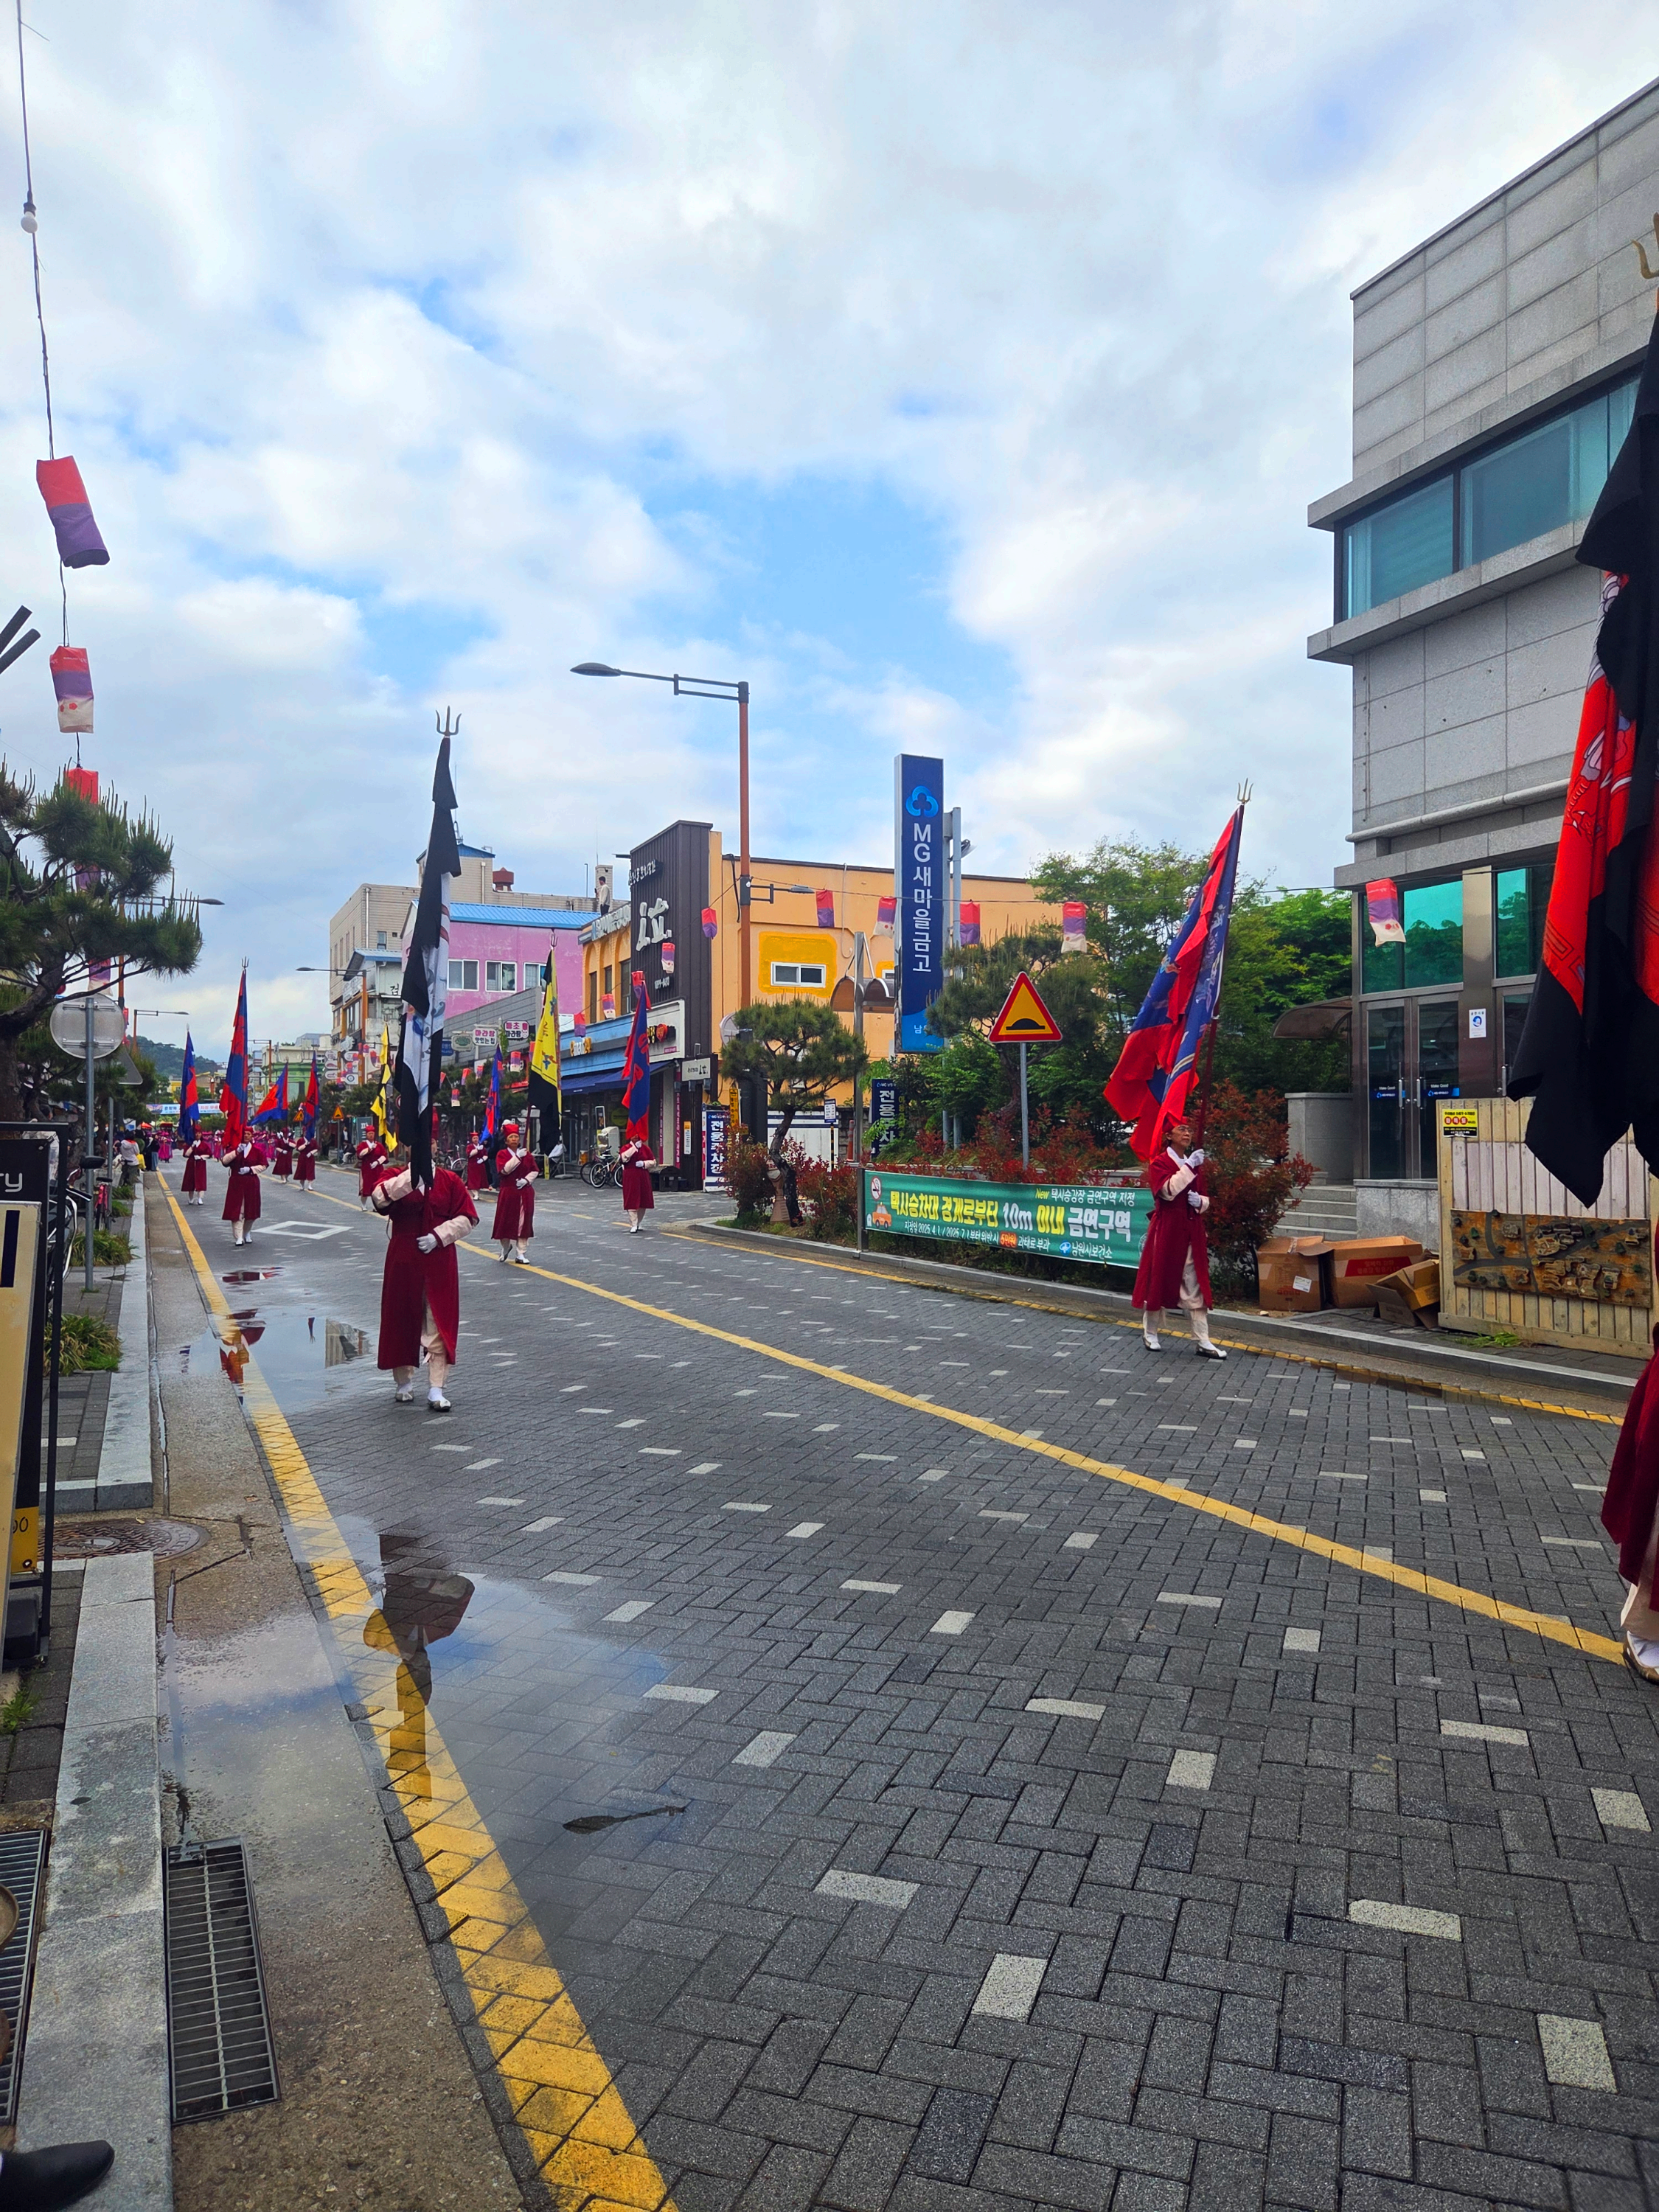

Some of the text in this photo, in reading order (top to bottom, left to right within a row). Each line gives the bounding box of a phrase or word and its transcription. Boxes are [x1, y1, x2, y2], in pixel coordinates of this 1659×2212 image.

[913, 823, 932, 973] MG새마을금고
[475, 1029, 495, 1037] 마라탕
[1035, 1188, 1135, 1207] New 택시승강장 금연구역 지정
[890, 1191, 1131, 1242] 택시승차대 경계로부터 10m 이내 금연구역
[904, 1220, 918, 1234] 지정일
[1001, 1234, 1017, 1248] 5만원
[1037, 1236, 1051, 1252] 부과
[1071, 1241, 1113, 1259] 남원시보건소
